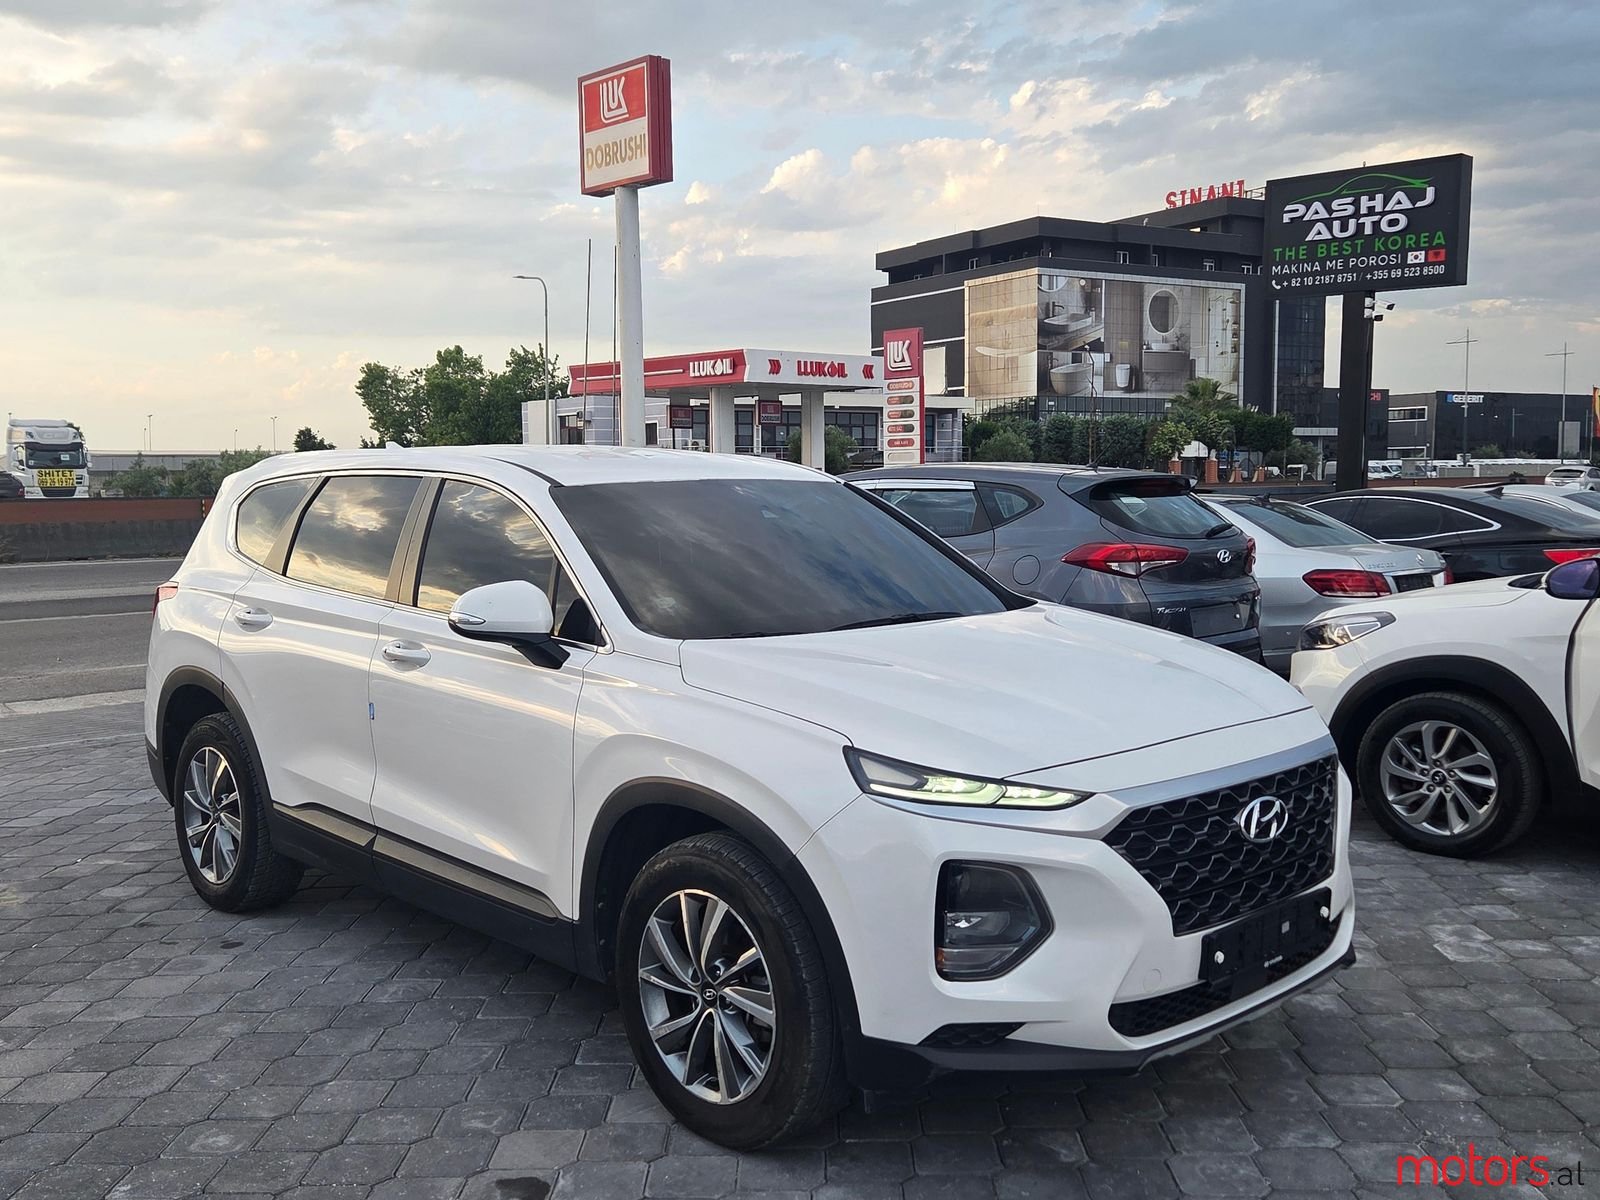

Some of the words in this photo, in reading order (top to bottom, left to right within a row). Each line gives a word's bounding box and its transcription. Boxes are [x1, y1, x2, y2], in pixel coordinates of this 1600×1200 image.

[585, 133, 647, 170] DOBRUSHI
[1165, 179, 1245, 208] SINANI
[1282, 186, 1436, 223] PASHAJ
[1304, 213, 1408, 242] AUTO
[1273, 245, 1308, 261] THE
[1317, 239, 1365, 258] BEST
[1375, 231, 1446, 252] KOREA
[1271, 261, 1321, 275] MAKINA
[1326, 259, 1344, 270] ME
[1349, 253, 1401, 268] POROSI
[1291, 277, 1301, 287] 82
[1304, 276, 1313, 286] 10
[1315, 274, 1335, 285] 2187
[1337, 272, 1357, 283] 8751
[1366, 270, 1388, 280] +355
[1391, 268, 1401, 278] 69
[1404, 266, 1420, 277] 523
[1423, 264, 1445, 275] 8500
